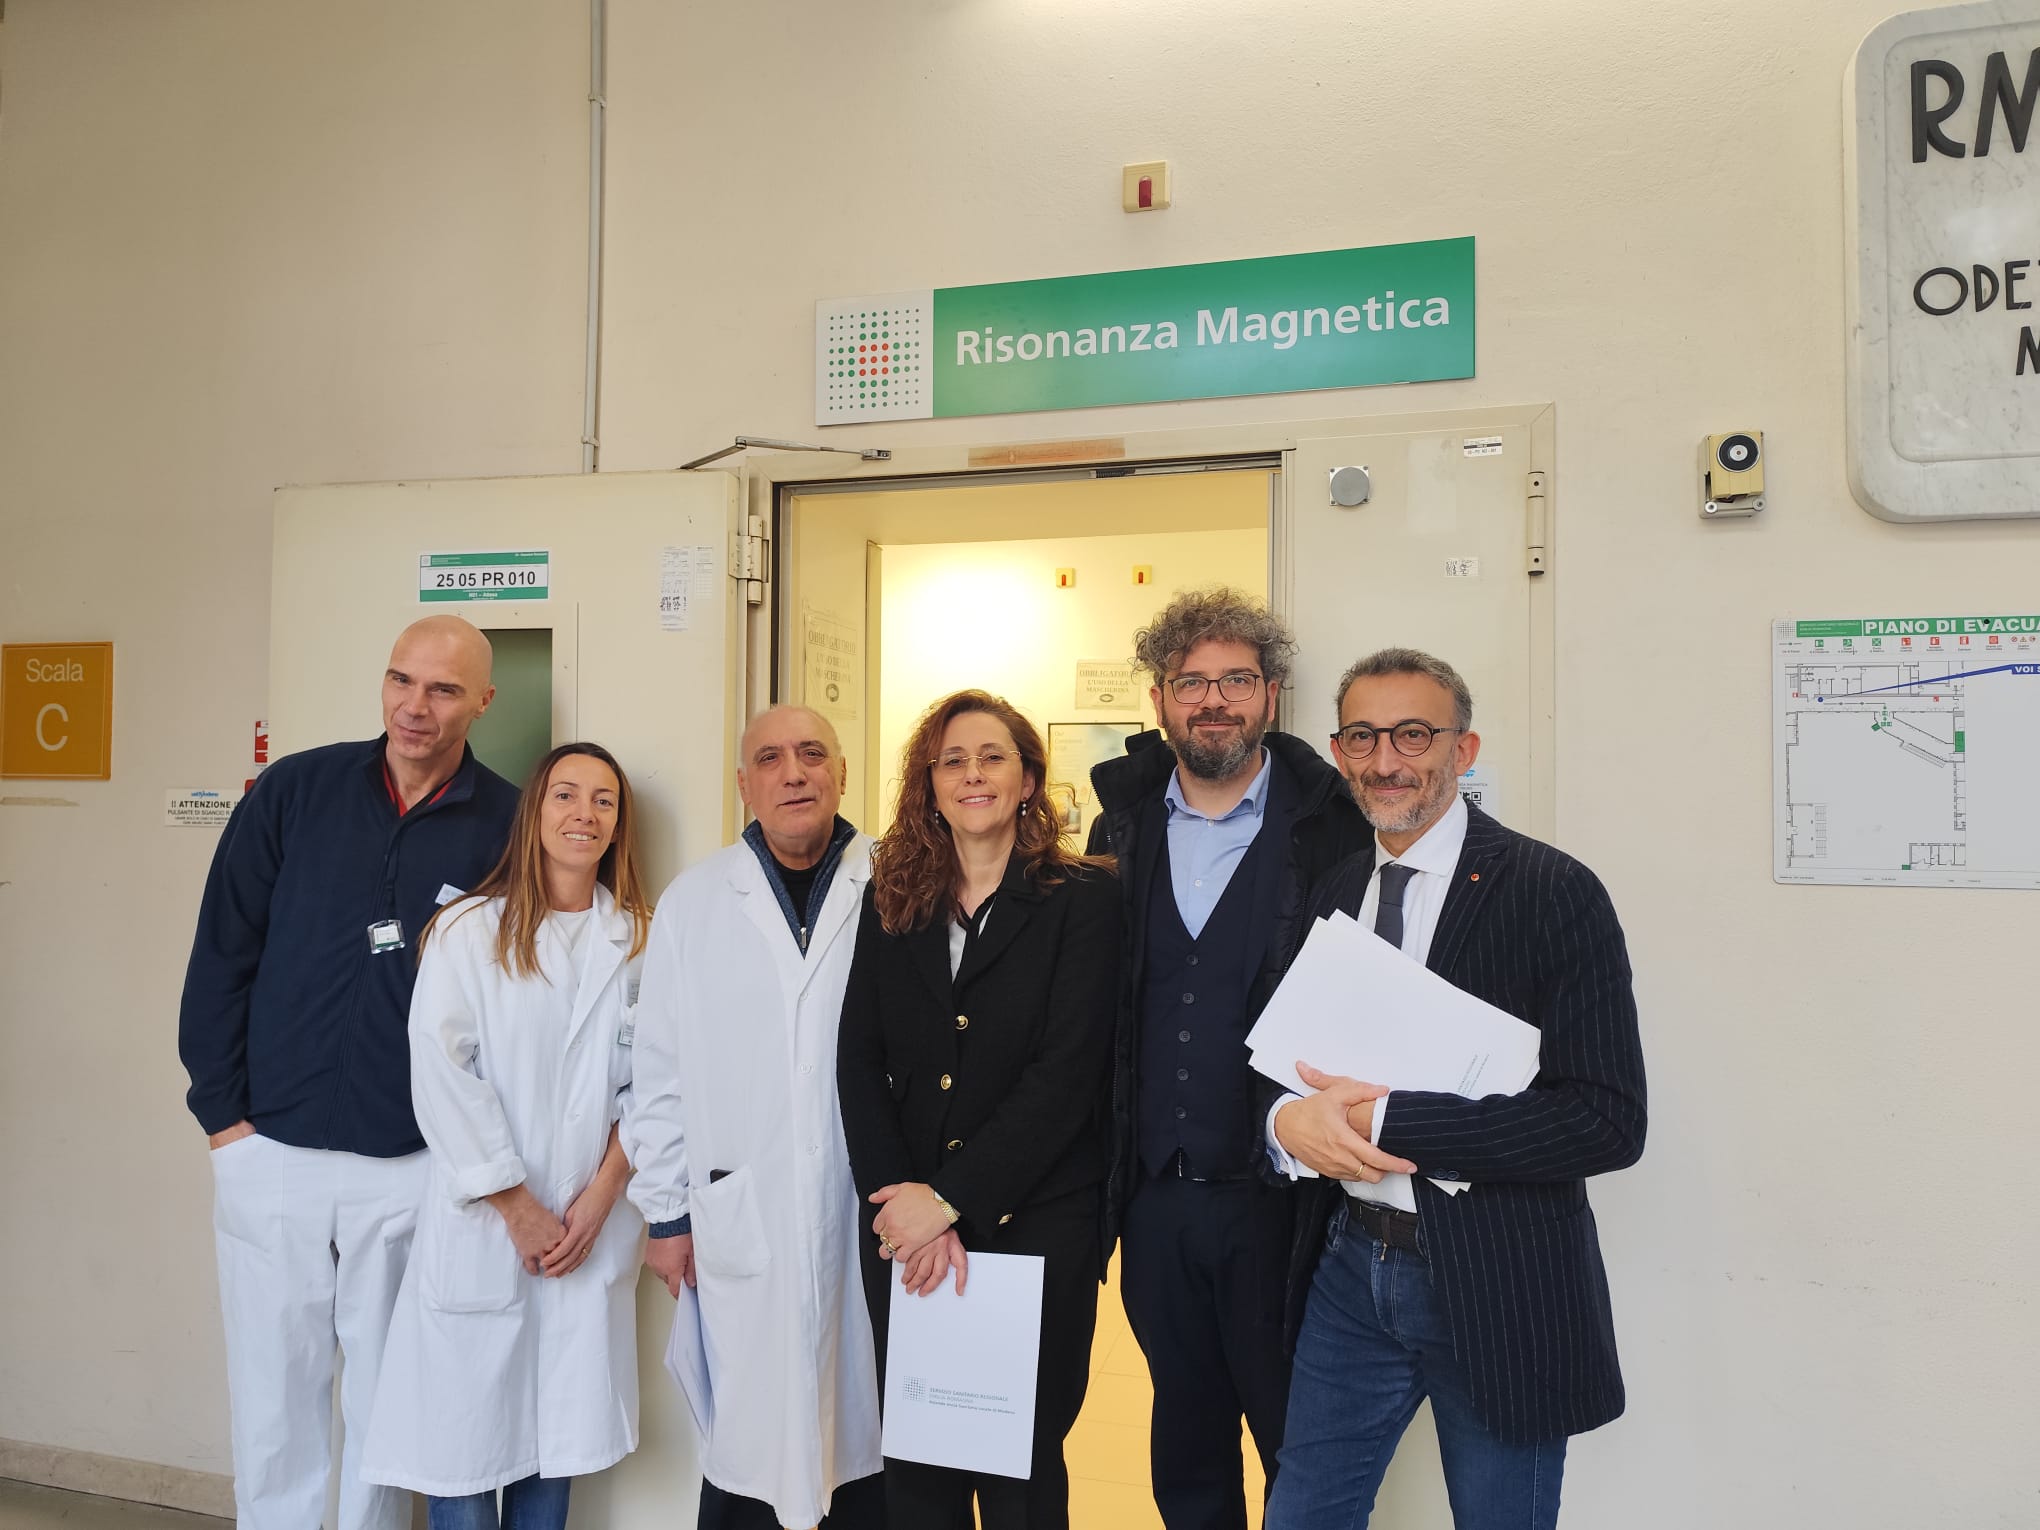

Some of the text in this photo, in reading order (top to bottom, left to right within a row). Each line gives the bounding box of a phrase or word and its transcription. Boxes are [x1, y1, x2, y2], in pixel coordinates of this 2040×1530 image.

[1913, 259, 2040, 316] ODE
[956, 290, 1450, 366] Risonanza Magnetica
[436, 571, 535, 587] 25 05 PR 010
[1865, 620, 1929, 634] PIANO
[1936, 619, 1956, 633] DI
[26, 657, 84, 682] Scala
[2014, 665, 2034, 673] VOI
[36, 703, 69, 751] C
[179, 800, 231, 809] ATTENZIONE
